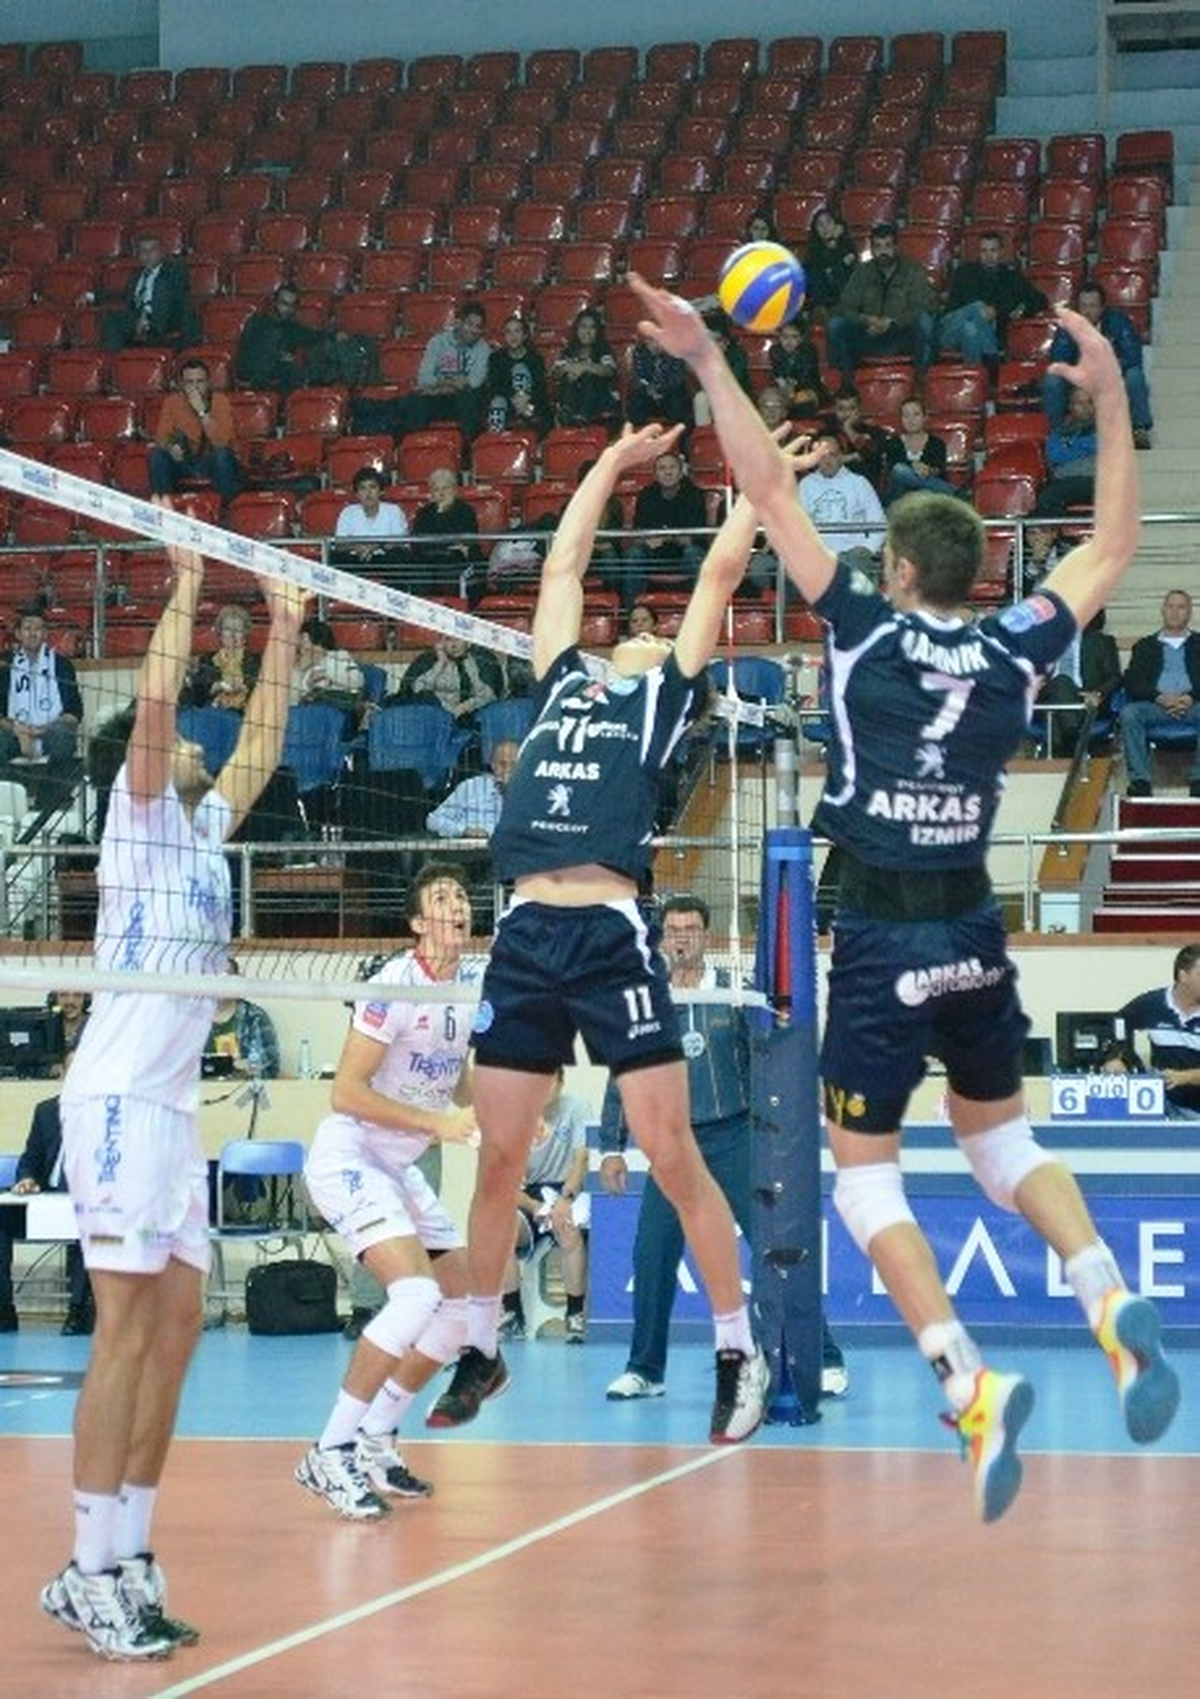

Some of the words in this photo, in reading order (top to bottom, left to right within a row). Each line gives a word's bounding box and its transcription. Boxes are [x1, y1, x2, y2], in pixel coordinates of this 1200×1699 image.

[921, 671, 976, 741] 7
[558, 716, 592, 753] 11
[535, 760, 600, 780] ARKAS
[867, 789, 981, 822] ARKAS
[917, 957, 983, 990] ARKAS
[623, 986, 654, 1022] 11
[445, 1005, 456, 1041] 6
[1059, 1087, 1077, 1111] 6
[1137, 1087, 1155, 1111] 0
